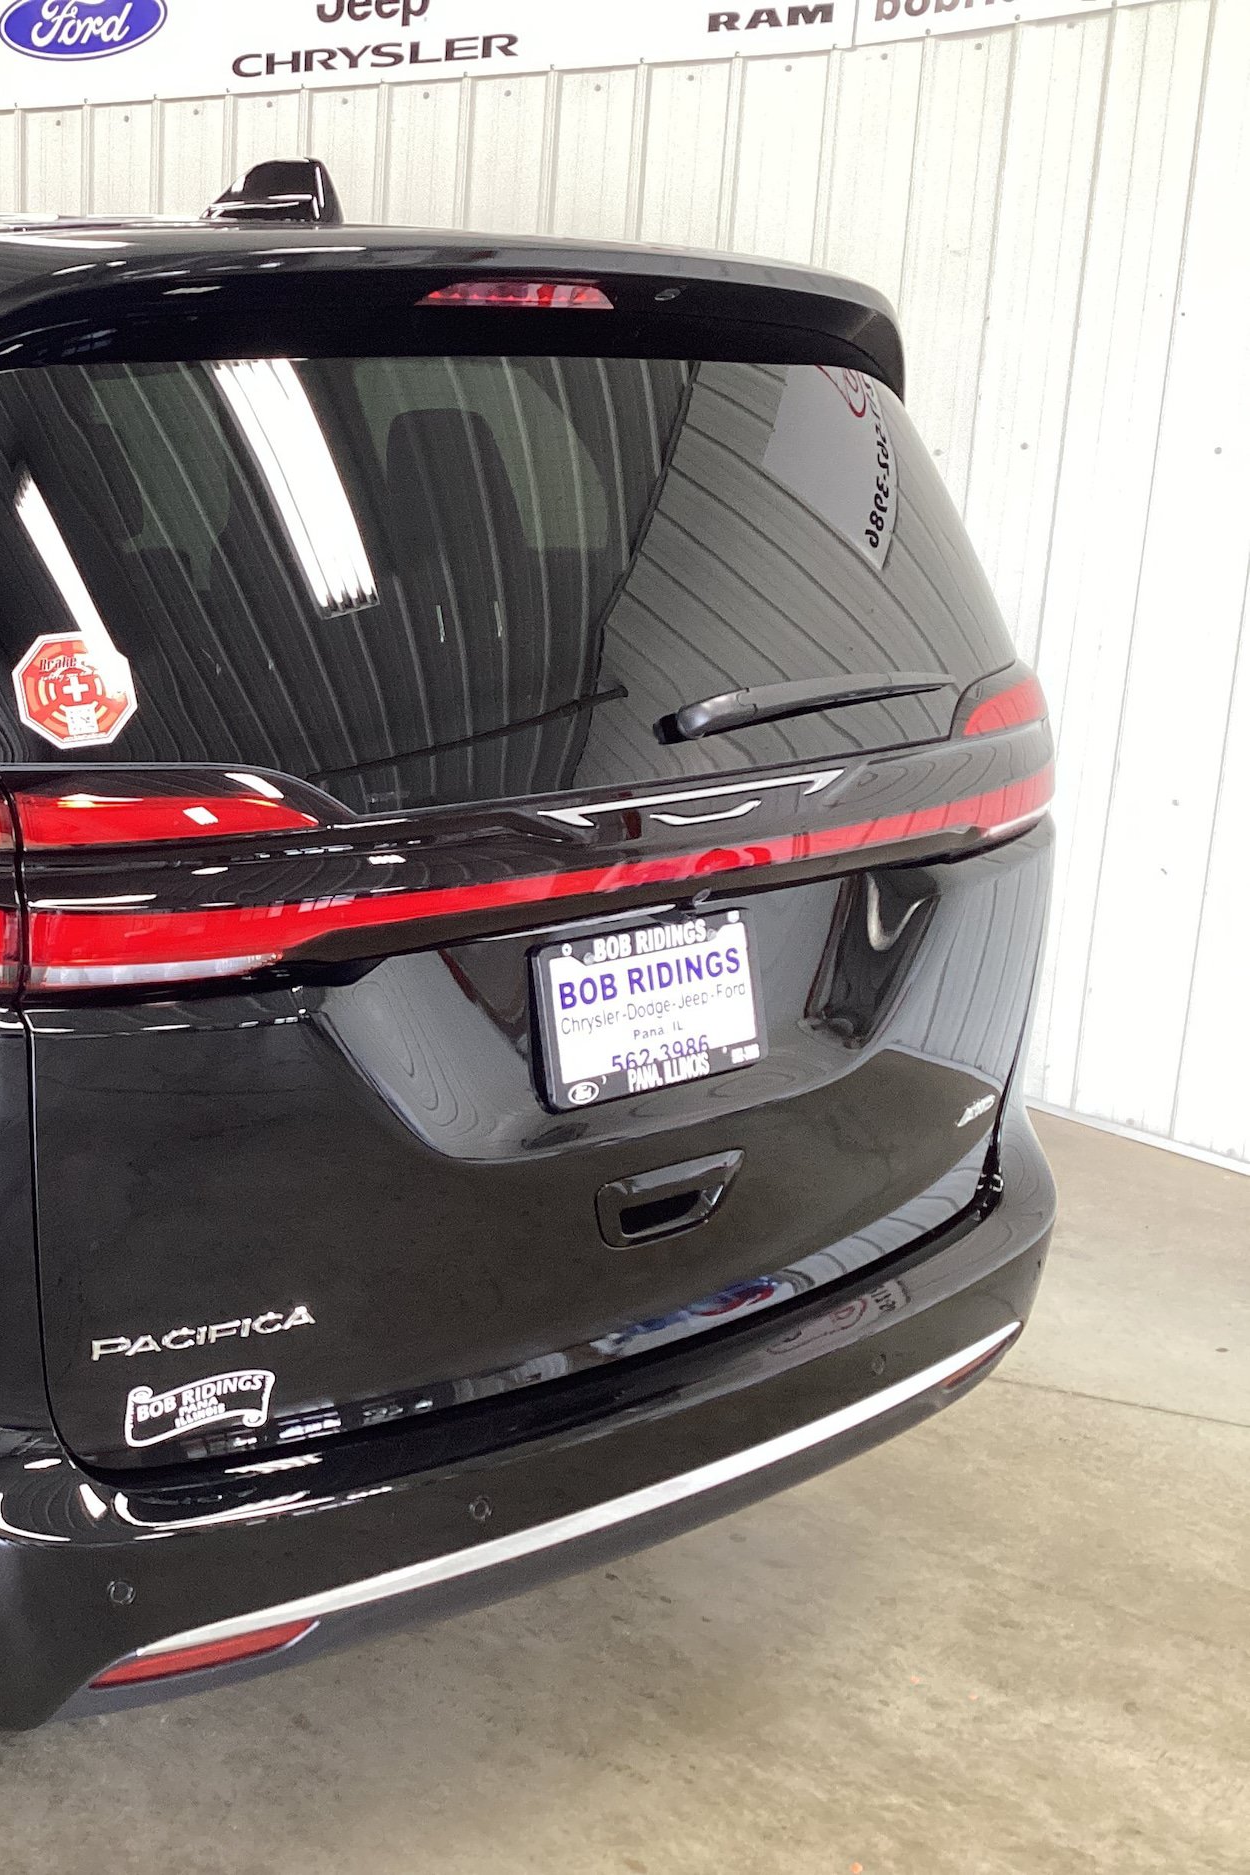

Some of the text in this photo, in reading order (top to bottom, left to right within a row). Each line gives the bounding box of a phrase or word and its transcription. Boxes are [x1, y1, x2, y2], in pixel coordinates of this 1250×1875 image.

[31, 0, 133, 48] Ford
[707, 2, 834, 32] RAM
[232, 33, 519, 78] CHRYSLER
[593, 918, 707, 963] BOB RIDINGS
[559, 947, 741, 1010] BOB RIDINGS
[633, 1027, 665, 1040] Pana
[91, 1306, 316, 1361] PACIFICA
[136, 1375, 265, 1422] BOB RIDINGS
